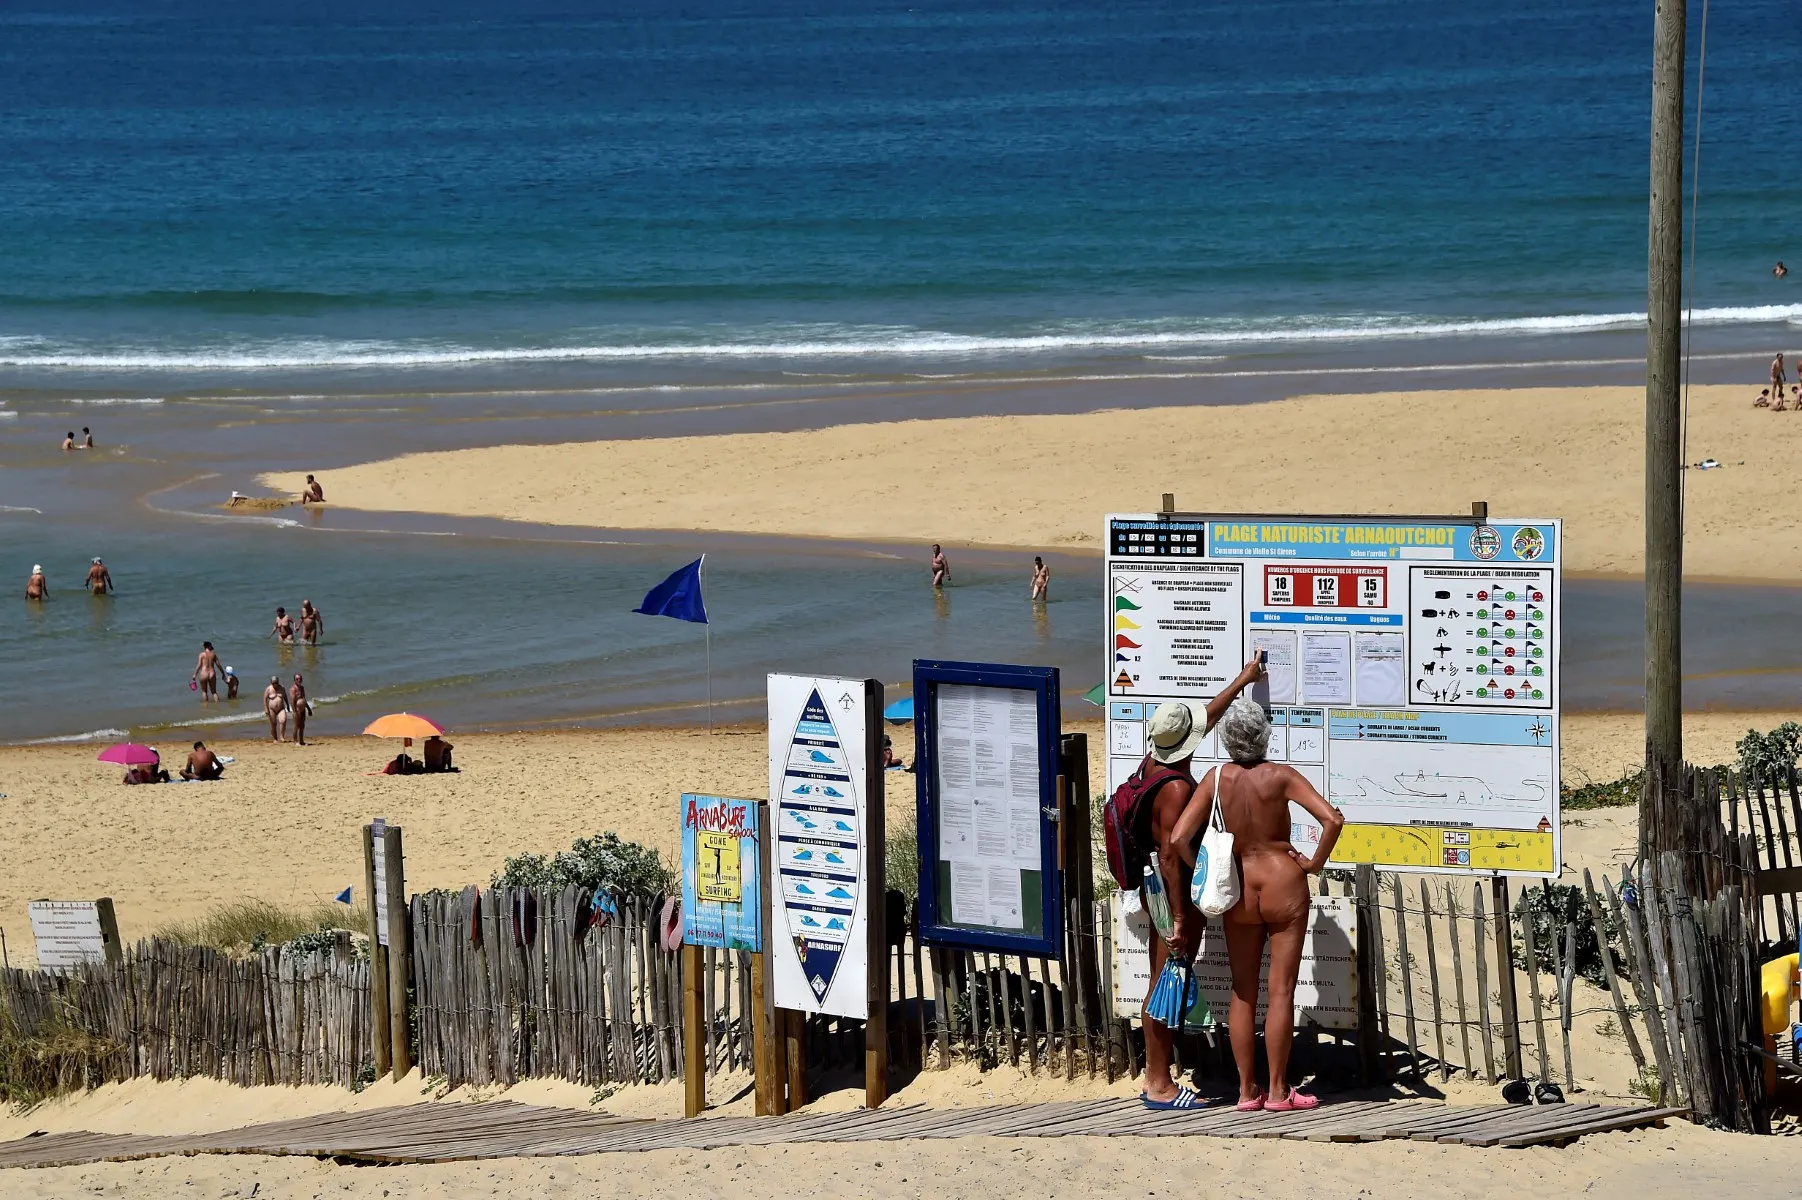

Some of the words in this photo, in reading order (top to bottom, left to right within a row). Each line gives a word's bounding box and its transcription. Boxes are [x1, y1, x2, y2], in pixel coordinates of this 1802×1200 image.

[1112, 522, 1129, 530] Plage
[1214, 525, 1258, 542] PLAGE
[1261, 526, 1340, 544] NATURISTE
[1275, 577, 1287, 589] 18
[1318, 578, 1334, 590] 112
[1364, 579, 1376, 591] 15
[728, 828, 754, 840] SCHOOL
[710, 836, 726, 846] GONE
[705, 886, 732, 896] SURFING
[808, 941, 841, 952] ARNASURF
